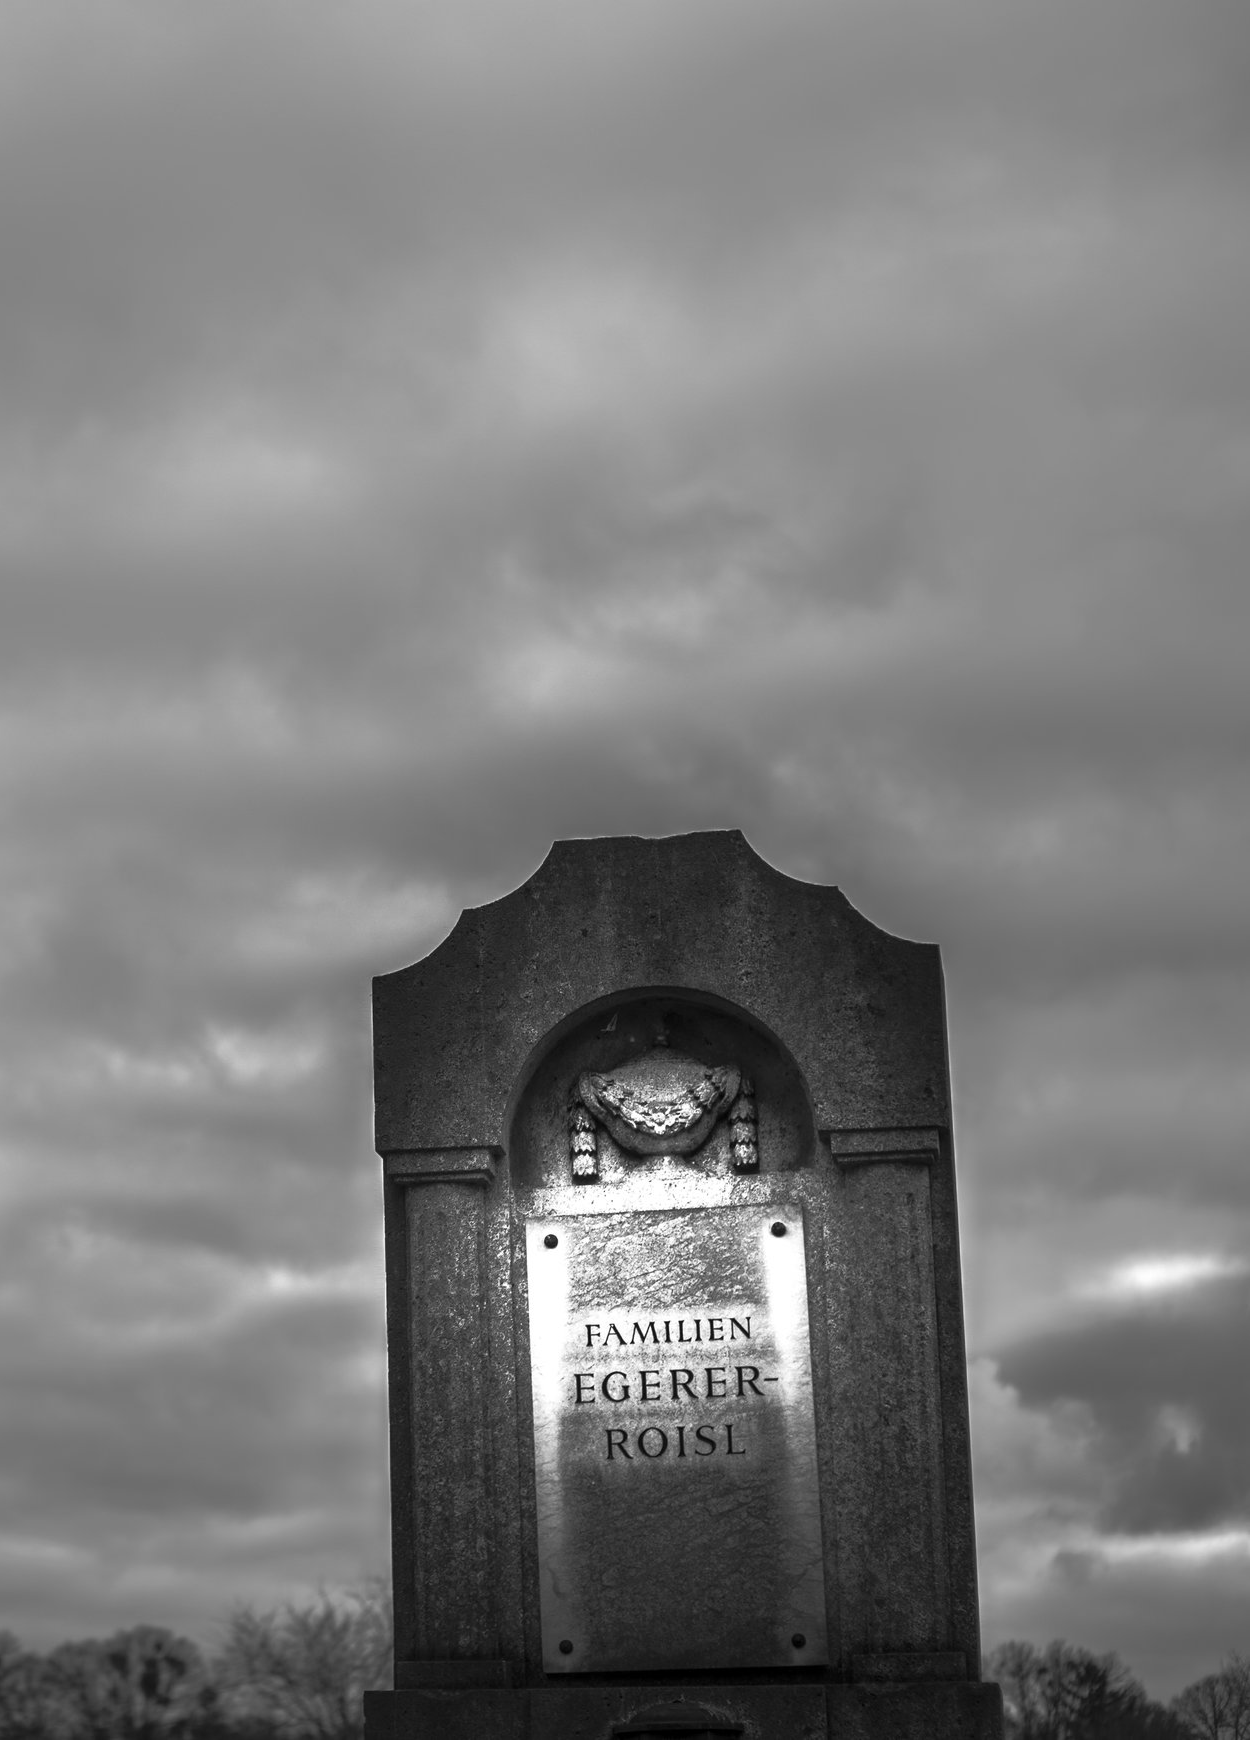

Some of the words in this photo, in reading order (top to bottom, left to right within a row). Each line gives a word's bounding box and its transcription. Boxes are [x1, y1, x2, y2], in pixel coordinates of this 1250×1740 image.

[585, 1316, 751, 1347] FAMILIEN
[573, 1365, 779, 1404] EGERER-
[605, 1424, 746, 1460] ROISL
